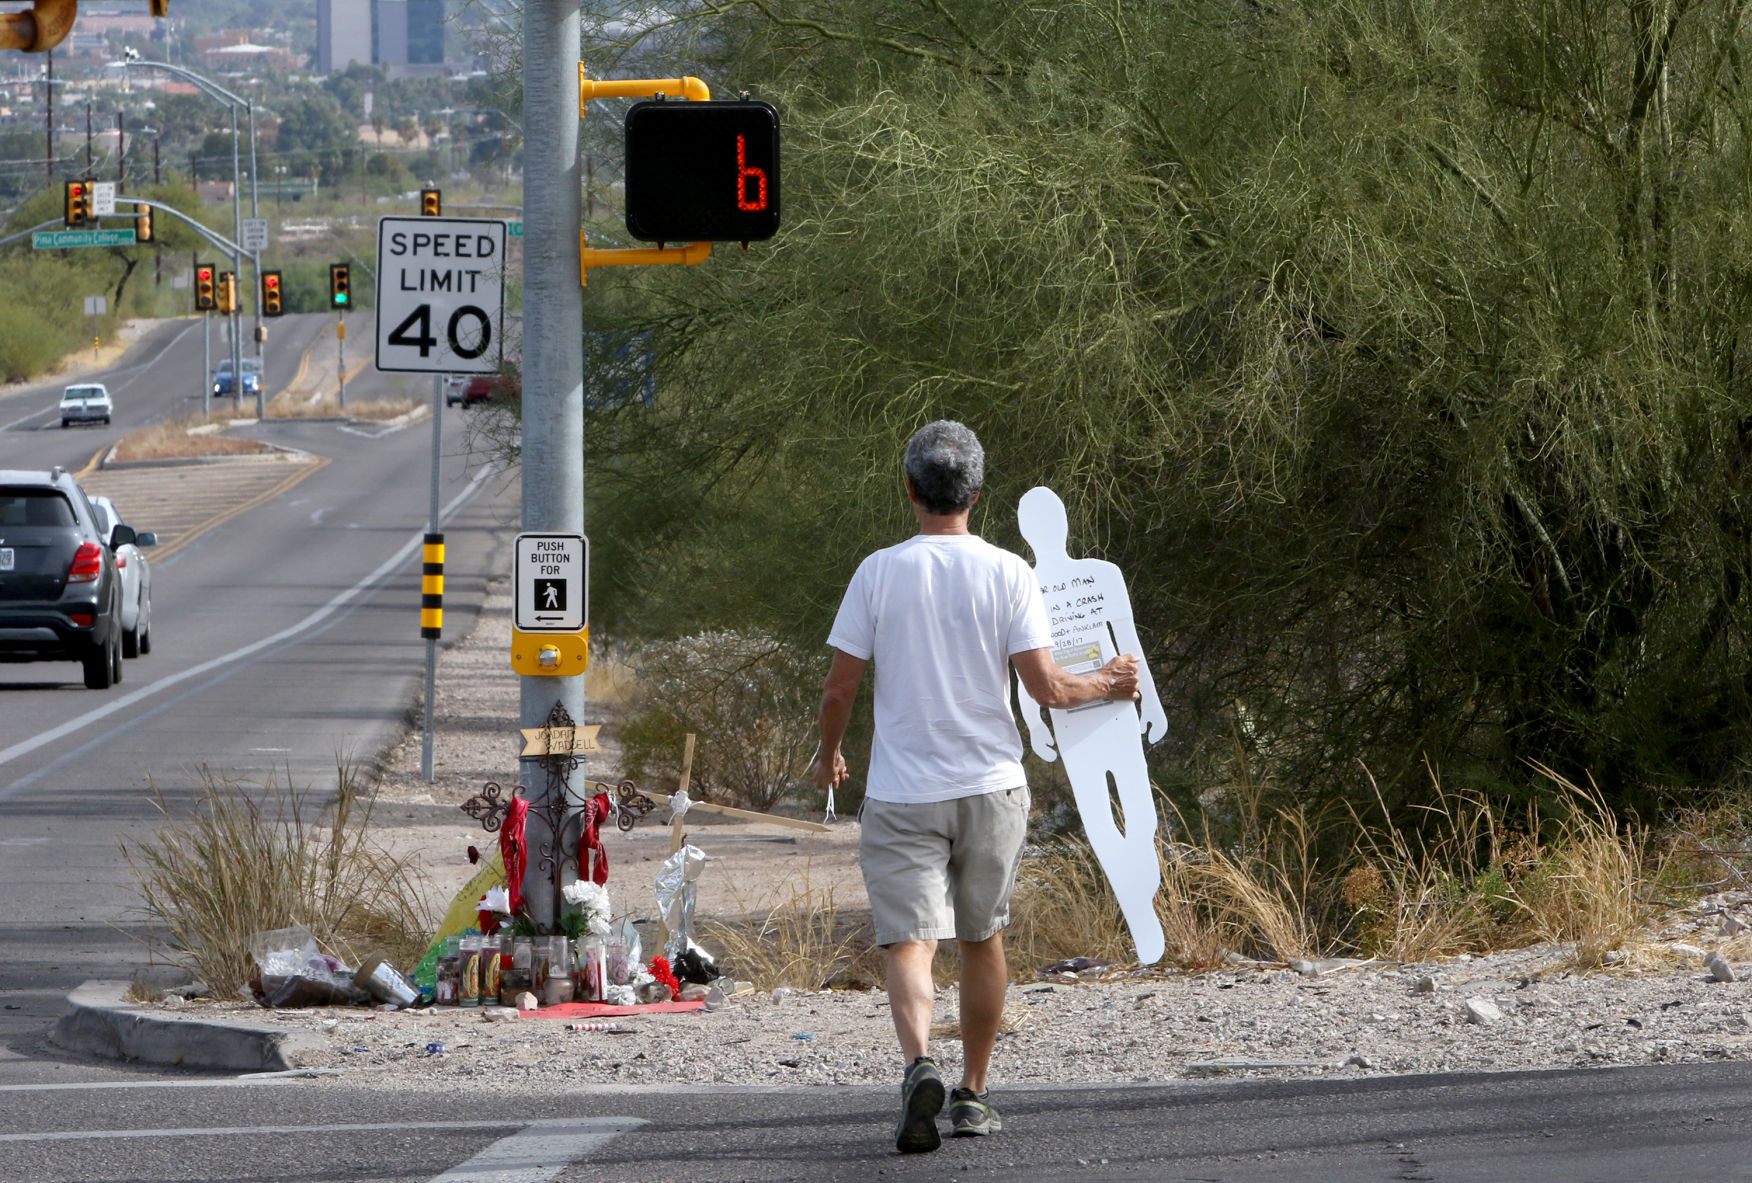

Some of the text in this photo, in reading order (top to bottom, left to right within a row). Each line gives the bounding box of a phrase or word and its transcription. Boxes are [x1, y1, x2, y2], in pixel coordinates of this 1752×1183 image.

[34, 234, 52, 245] Pima
[54, 232, 92, 246] Community
[94, 231, 119, 244] College
[390, 232, 495, 258] SPEED
[400, 268, 482, 293] LIMIT
[388, 303, 492, 360] 40
[537, 541, 564, 551] PUSH
[531, 553, 570, 563] BUTTON
[540, 565, 560, 575] FOR
[1053, 582, 1066, 592] OLD
[1071, 576, 1095, 589] MAN
[1050, 604, 1061, 612] IN
[1076, 593, 1104, 607] CRASH
[1052, 607, 1103, 626] DRIVING AT
